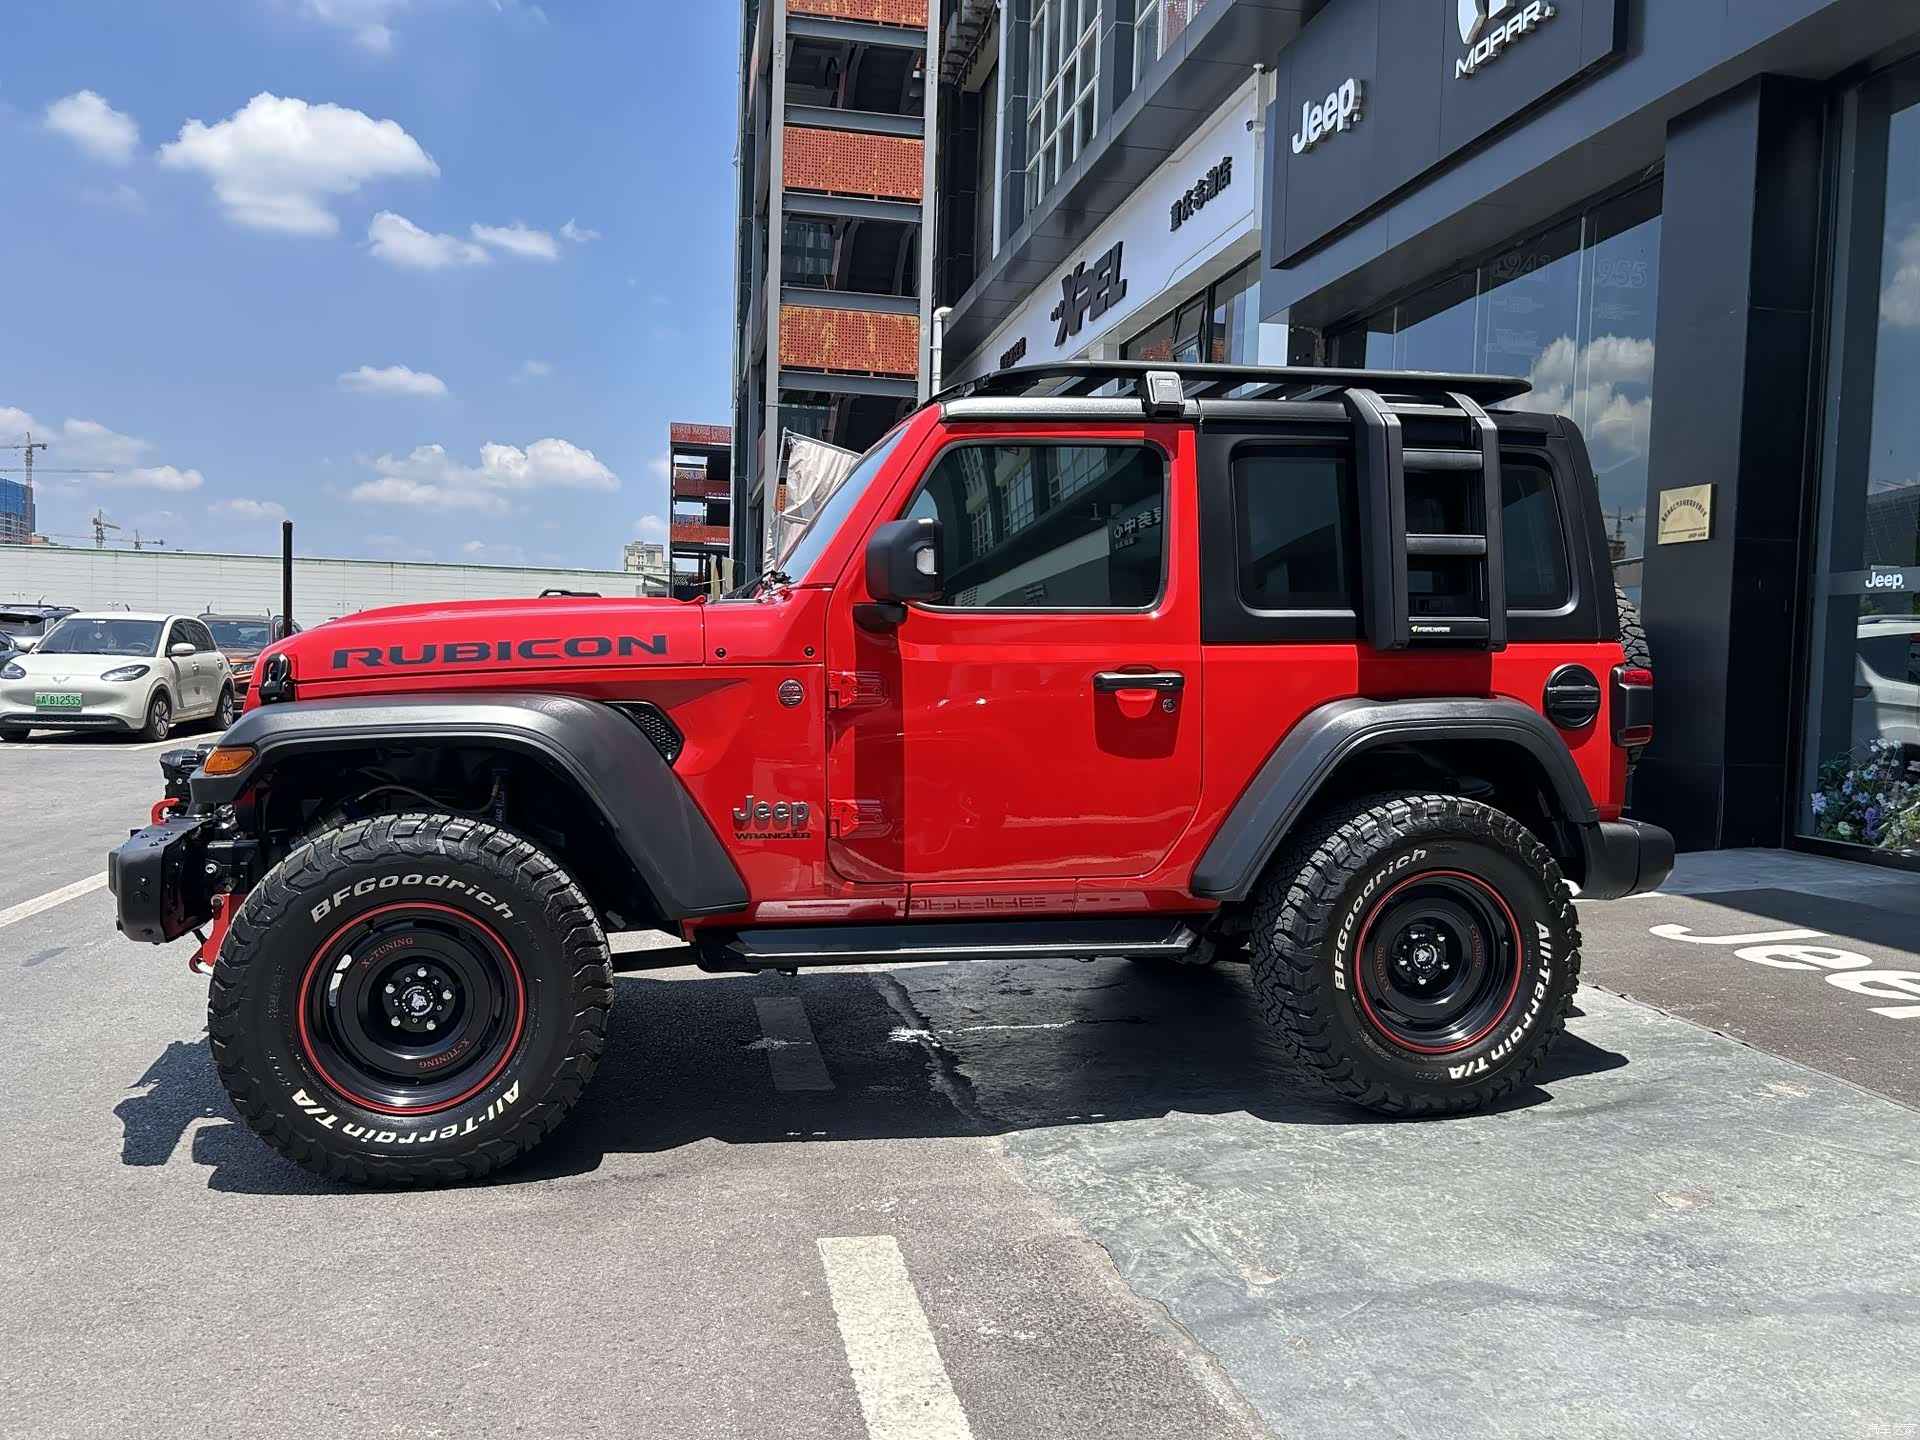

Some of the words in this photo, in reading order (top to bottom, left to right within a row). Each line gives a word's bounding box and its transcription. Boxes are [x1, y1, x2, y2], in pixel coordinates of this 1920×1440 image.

[1292, 78, 1356, 154] Jeep
[1053, 241, 1128, 347] XPEL
[1865, 571, 1904, 589] Jeep
[331, 635, 669, 669] RUBICON
[733, 795, 810, 826] Jeep
[735, 832, 811, 840] WRANGLER
[310, 874, 514, 923] BFGoodrich
[1334, 849, 1427, 991] BFGoodrich
[361, 937, 413, 968] X-TUNING
[1649, 923, 1920, 1019] Jee
[1490, 920, 1552, 1061] All-Terrain
[419, 1037, 470, 1069] X-TUNING
[1448, 1057, 1489, 1079] T/A
[291, 1089, 339, 1129] T/A
[342, 1079, 519, 1144] All-Terrain
